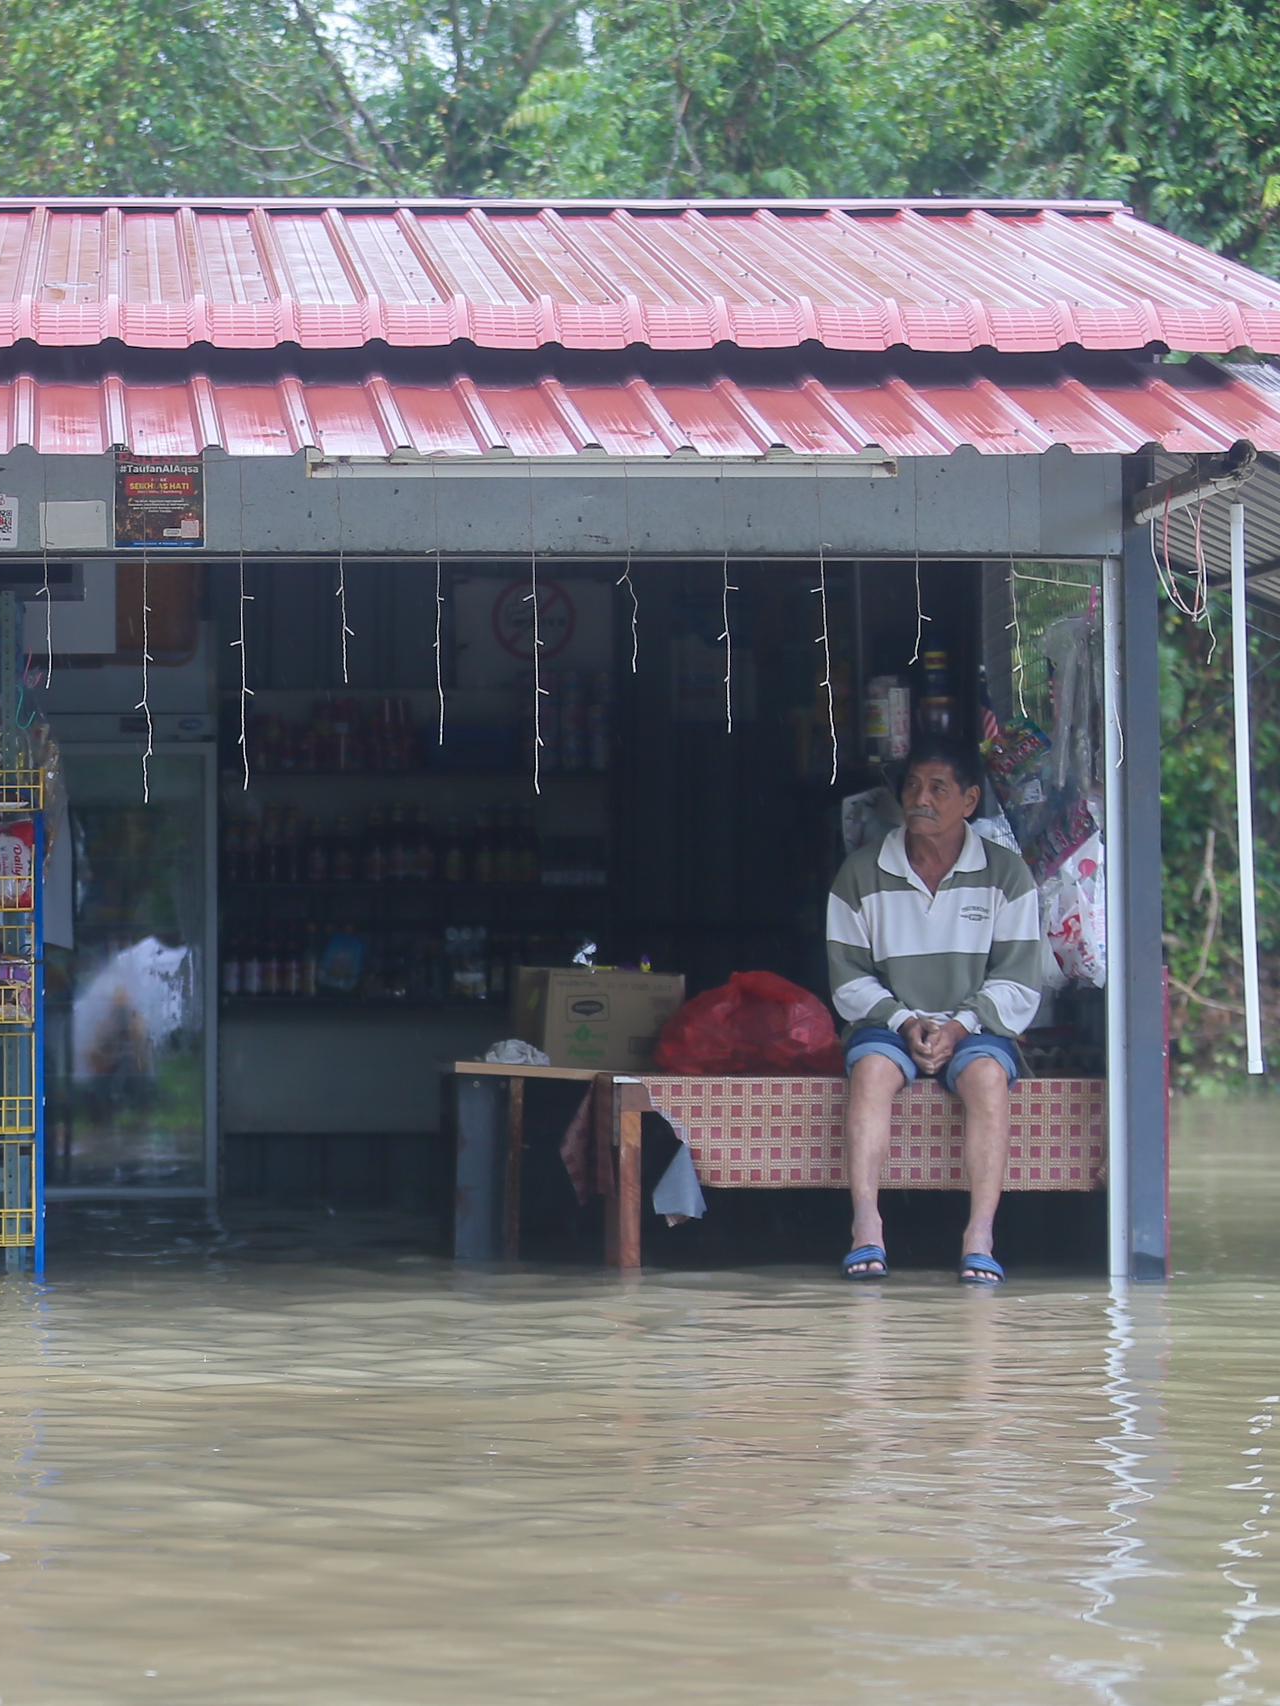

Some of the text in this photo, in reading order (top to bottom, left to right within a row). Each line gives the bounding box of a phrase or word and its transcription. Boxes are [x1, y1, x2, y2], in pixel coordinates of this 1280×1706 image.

[120, 464, 199, 475] #TaufanAlAqsa
[169, 482, 189, 490] HATI
[12, 844, 23, 876] Daily
